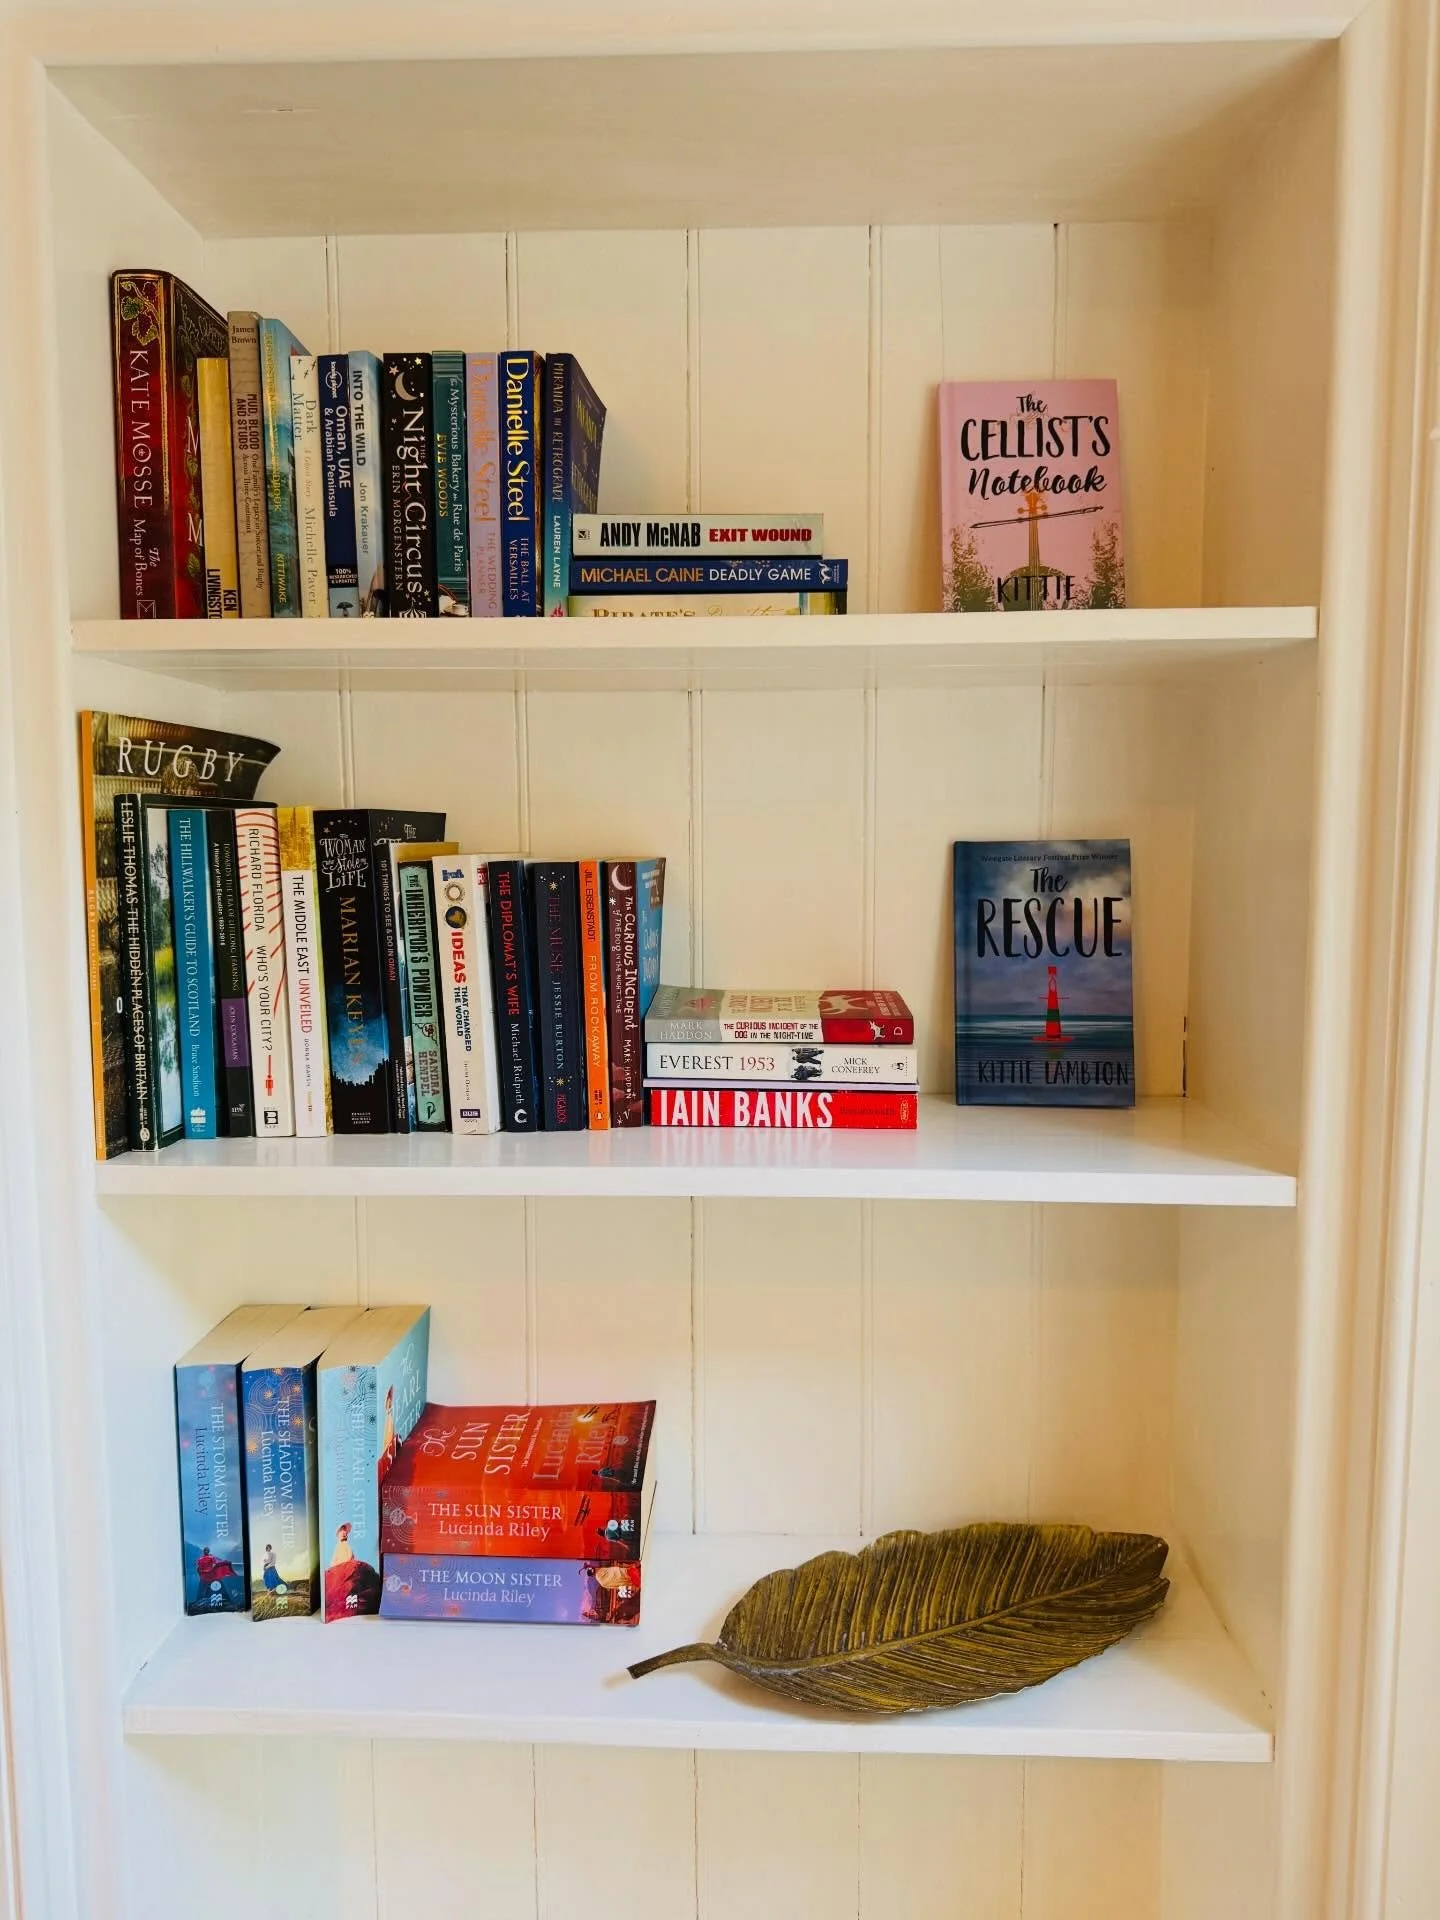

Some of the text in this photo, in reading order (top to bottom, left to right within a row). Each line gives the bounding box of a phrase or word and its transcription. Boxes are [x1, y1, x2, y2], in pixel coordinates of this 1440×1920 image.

[235, 398, 248, 450] AND STUDS
[246, 394, 260, 450] MUD, BLOOD
[292, 392, 304, 441] Matter
[305, 400, 318, 433] Dark
[353, 370, 366, 466] INTO THE WILD
[1016, 393, 1048, 413] The
[129, 350, 153, 509] KATE MOSSE
[335, 405, 351, 489] Oman, UAE
[506, 358, 531, 521] Danielle Steel
[960, 416, 1111, 461] CELLIST'S
[251, 453, 259, 468] One
[251, 469, 261, 497] Family's
[324, 418, 338, 517] Arabian Peninsula
[436, 433, 449, 517] EVIE WOODS
[968, 465, 1107, 500] Notebook
[358, 482, 370, 555] Jon Krakauer
[397, 407, 430, 593] Night Circus
[255, 531, 263, 552] Soccer
[392, 465, 404, 592] ERIN MORGENSTERN
[553, 515, 562, 588] LAUREN LAYNE
[600, 522, 641, 547] ANDY
[646, 522, 701, 547] McNAB
[708, 528, 748, 542] EXIT
[752, 528, 812, 542] WOUND
[128, 519, 147, 596] Map of Bones
[255, 568, 265, 590] Rugby
[256, 554, 264, 567] and
[304, 507, 320, 605] Michelle Paver
[508, 539, 519, 600] VERSAILLES
[521, 560, 530, 586] BALL
[581, 568, 811, 583] MICHAEL CAINE DEADLY GAME
[223, 589, 237, 611] KEN
[487, 555, 498, 609] WEDDING
[997, 575, 1076, 603] KITTIE
[117, 737, 245, 782] RUGBY
[120, 802, 134, 843] LESLIE
[123, 845, 138, 905] THOMAS
[223, 843, 232, 877] TOWARDS
[1030, 867, 1067, 892] The
[127, 909, 140, 934] THE
[381, 873, 392, 927] THINGS TO SEE
[179, 818, 200, 1037] THE HILLWALKER'S GUIDE TO SCOTLAND
[248, 828, 273, 1051] RICHARD FLORIDA WHO'S YOUR CITY?
[976, 897, 1123, 959] RESCUE
[128, 937, 143, 986] HIDDEN
[292, 875, 313, 1034] THE MIDDLE EAST UNVEILED
[405, 889, 432, 1018] INHERITOR'S POWDER
[451, 931, 467, 984] IDEAS
[339, 896, 364, 1066] MARIAN KEYES
[461, 986, 469, 1008] THAT
[498, 872, 526, 1104] THE DIPLOMAT'S WIFE Michael Ridpath
[585, 888, 601, 1068] EISENSTADT FROM ROCKAWAY
[130, 989, 146, 1032] PLACES
[453, 986, 464, 1037] THE WORLD
[462, 1009, 472, 1052] CHANGED
[552, 981, 566, 1070] JESSIE BURTON
[670, 1021, 703, 1030] MARK
[735, 1021, 767, 1030] CURIOUS
[768, 1021, 799, 1030] INCIDENT
[660, 1031, 712, 1040] HADDON
[734, 1030, 748, 1039] DOG
[773, 1031, 814, 1040] NIGHT-TIME
[134, 1052, 148, 1100] BRITAIN
[418, 1051, 431, 1097] HEMPEL
[428, 1050, 440, 1096] SANDRA
[659, 1054, 776, 1072] EVEREST 1953
[831, 1065, 880, 1074] CONEFREY
[977, 1060, 1129, 1085] KITTIE LAMBTON
[660, 1089, 833, 1128] IAIN BANKS
[277, 1396, 293, 1499] THE SHADOW
[451, 1422, 490, 1461] SUN
[484, 1408, 533, 1475] SISTER
[195, 1427, 212, 1515] Lucinda Riley
[211, 1402, 229, 1538] THE STORM SISTER
[261, 1430, 277, 1518] Lucinda Riley
[352, 1489, 367, 1539] SISTER
[428, 1502, 563, 1520] THE SUN SISTER
[439, 1521, 551, 1542] Lucinda Riley
[419, 1569, 563, 1587] THE MOON SISTER
[443, 1588, 535, 1606] Lucinda Riley
